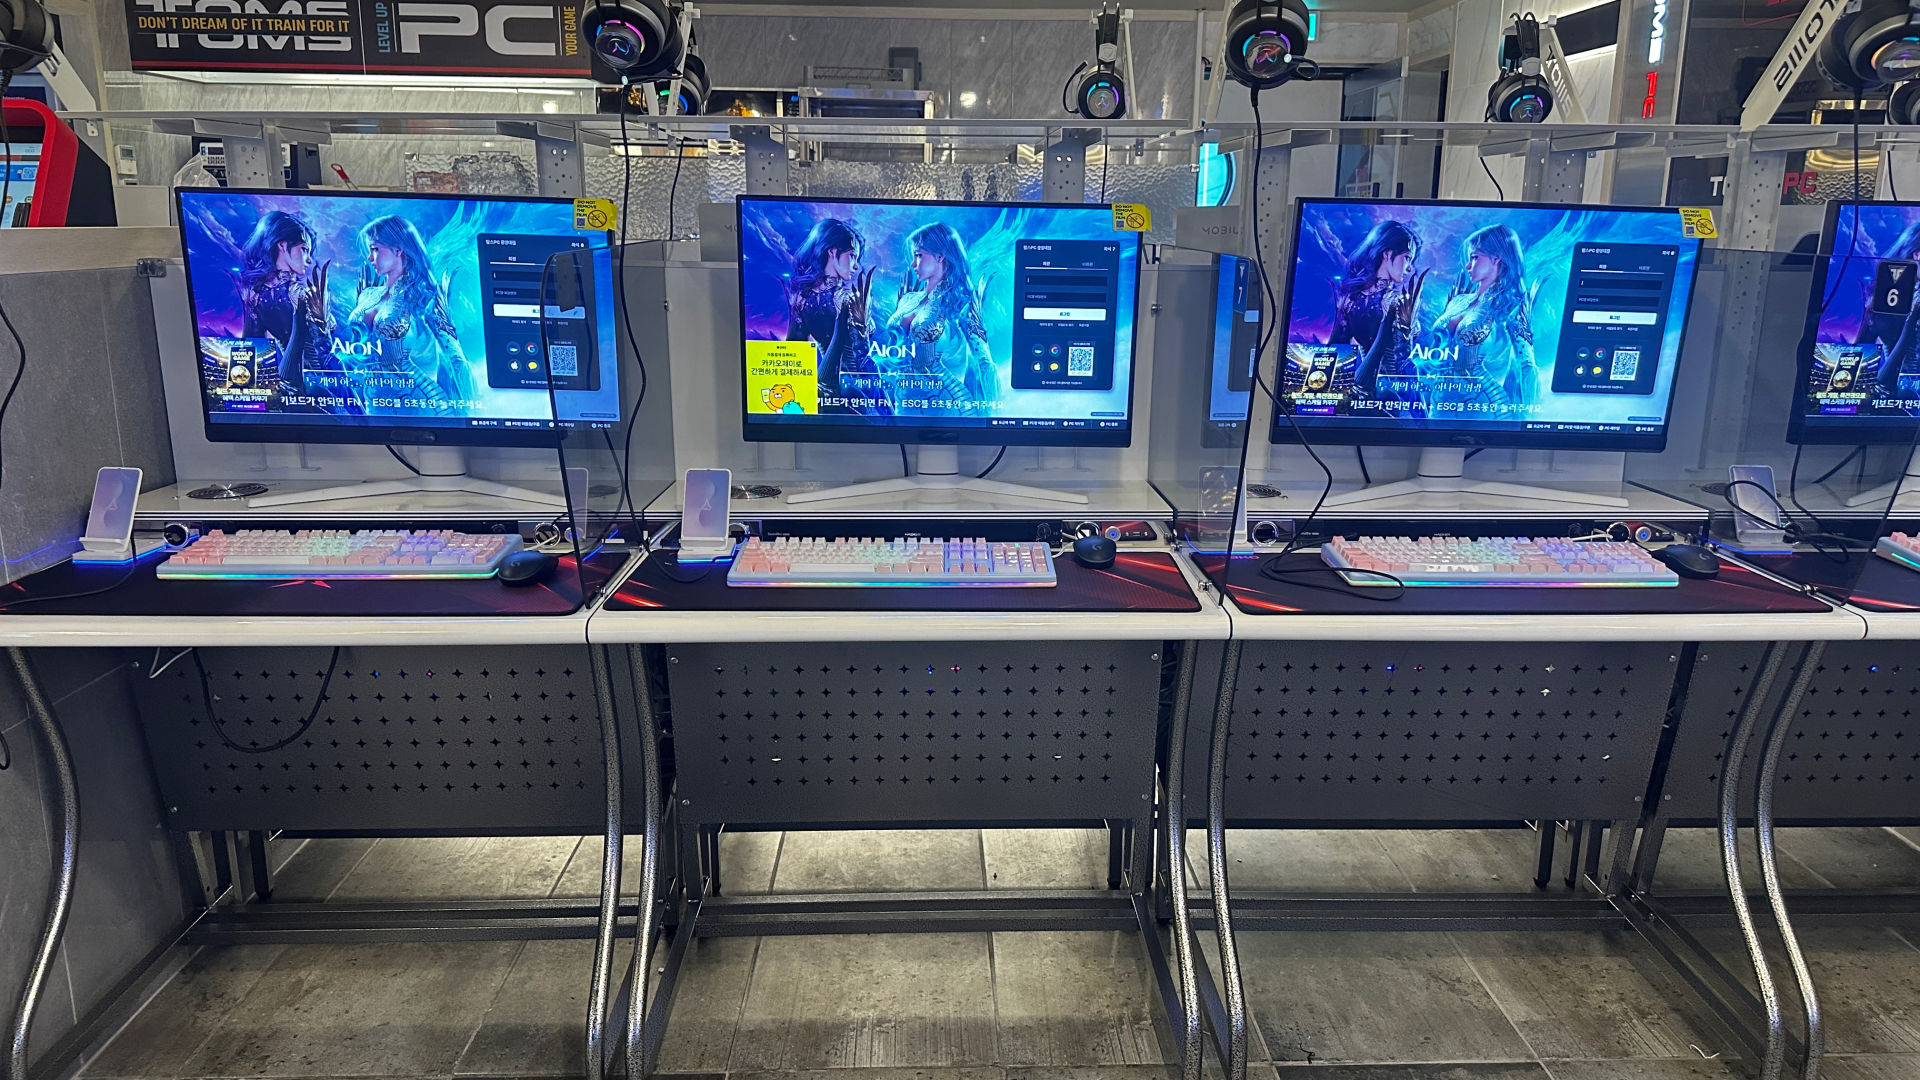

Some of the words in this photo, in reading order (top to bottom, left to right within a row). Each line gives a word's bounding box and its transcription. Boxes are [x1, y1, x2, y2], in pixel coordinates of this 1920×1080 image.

[376, 2, 388, 18] UP
[564, 6, 576, 30] GAME
[138, 16, 178, 29] DON'T
[182, 17, 227, 31] DREAM
[231, 18, 248, 31] OF
[252, 18, 264, 31] IT
[266, 19, 305, 32] TRAIN
[310, 19, 334, 33] FOR
[337, 20, 349, 33] IT
[398, 3, 557, 56] PC
[378, 21, 390, 52] LEVEL
[565, 31, 578, 56] YOUR
[1783, 172, 1818, 195] PC
[1887, 289, 1899, 306] 6
[330, 337, 382, 357] AION
[867, 341, 916, 359] AION
[1408, 343, 1459, 361] AION
[780, 368, 813, 376] 결제하세요
[281, 396, 315, 407] 키보드가
[318, 397, 344, 407] 안되면
[347, 398, 361, 406] FN
[817, 397, 848, 407] 키보드가
[851, 398, 875, 407] 안되면
[878, 399, 892, 407] FN
[1350, 400, 1383, 410] 키보드가
[1385, 401, 1410, 410] 안되면
[1412, 402, 1426, 410] FN
[1872, 400, 1903, 409] 키보드가
